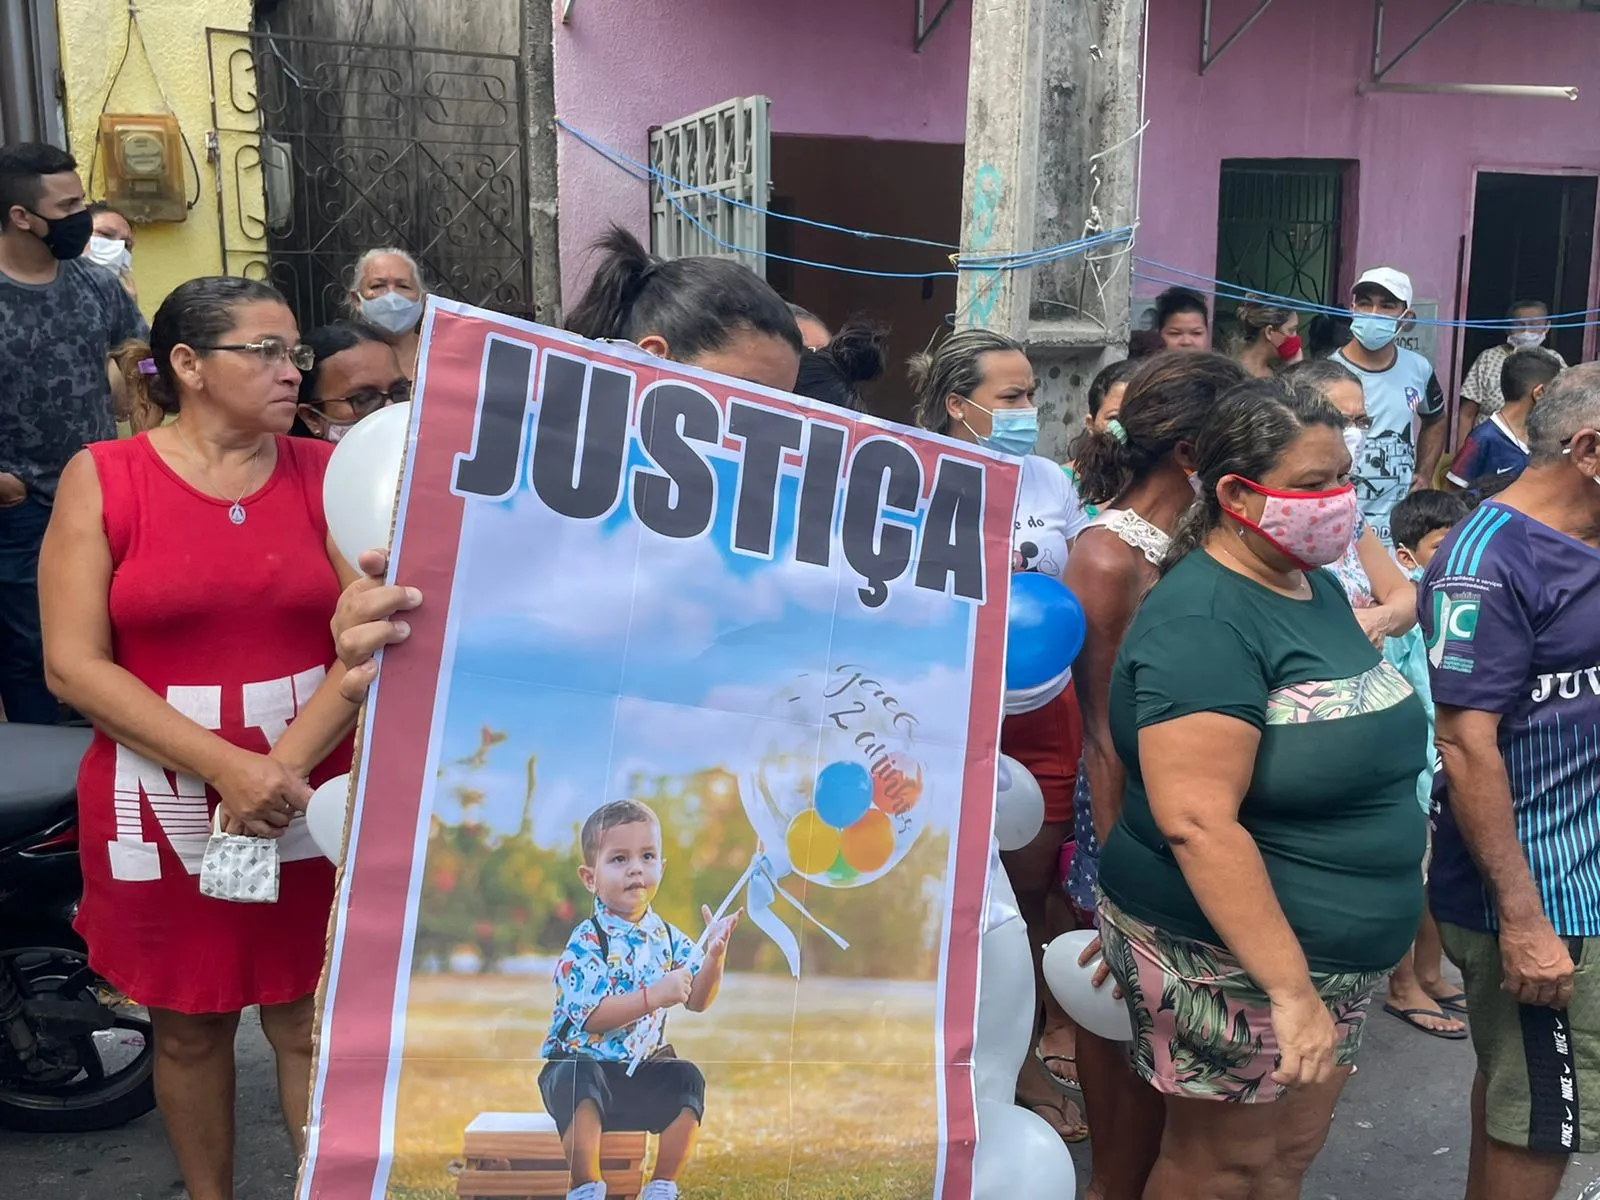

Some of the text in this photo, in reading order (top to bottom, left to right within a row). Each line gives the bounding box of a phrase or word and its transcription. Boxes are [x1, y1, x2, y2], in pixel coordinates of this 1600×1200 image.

[453, 334, 988, 608] JUSTIÇA
[828, 701, 866, 731] 2
[1553, 1031, 1569, 1055] NIKE
[1560, 1075, 1574, 1101] NIKE
[1560, 1121, 1573, 1148] NIKE
